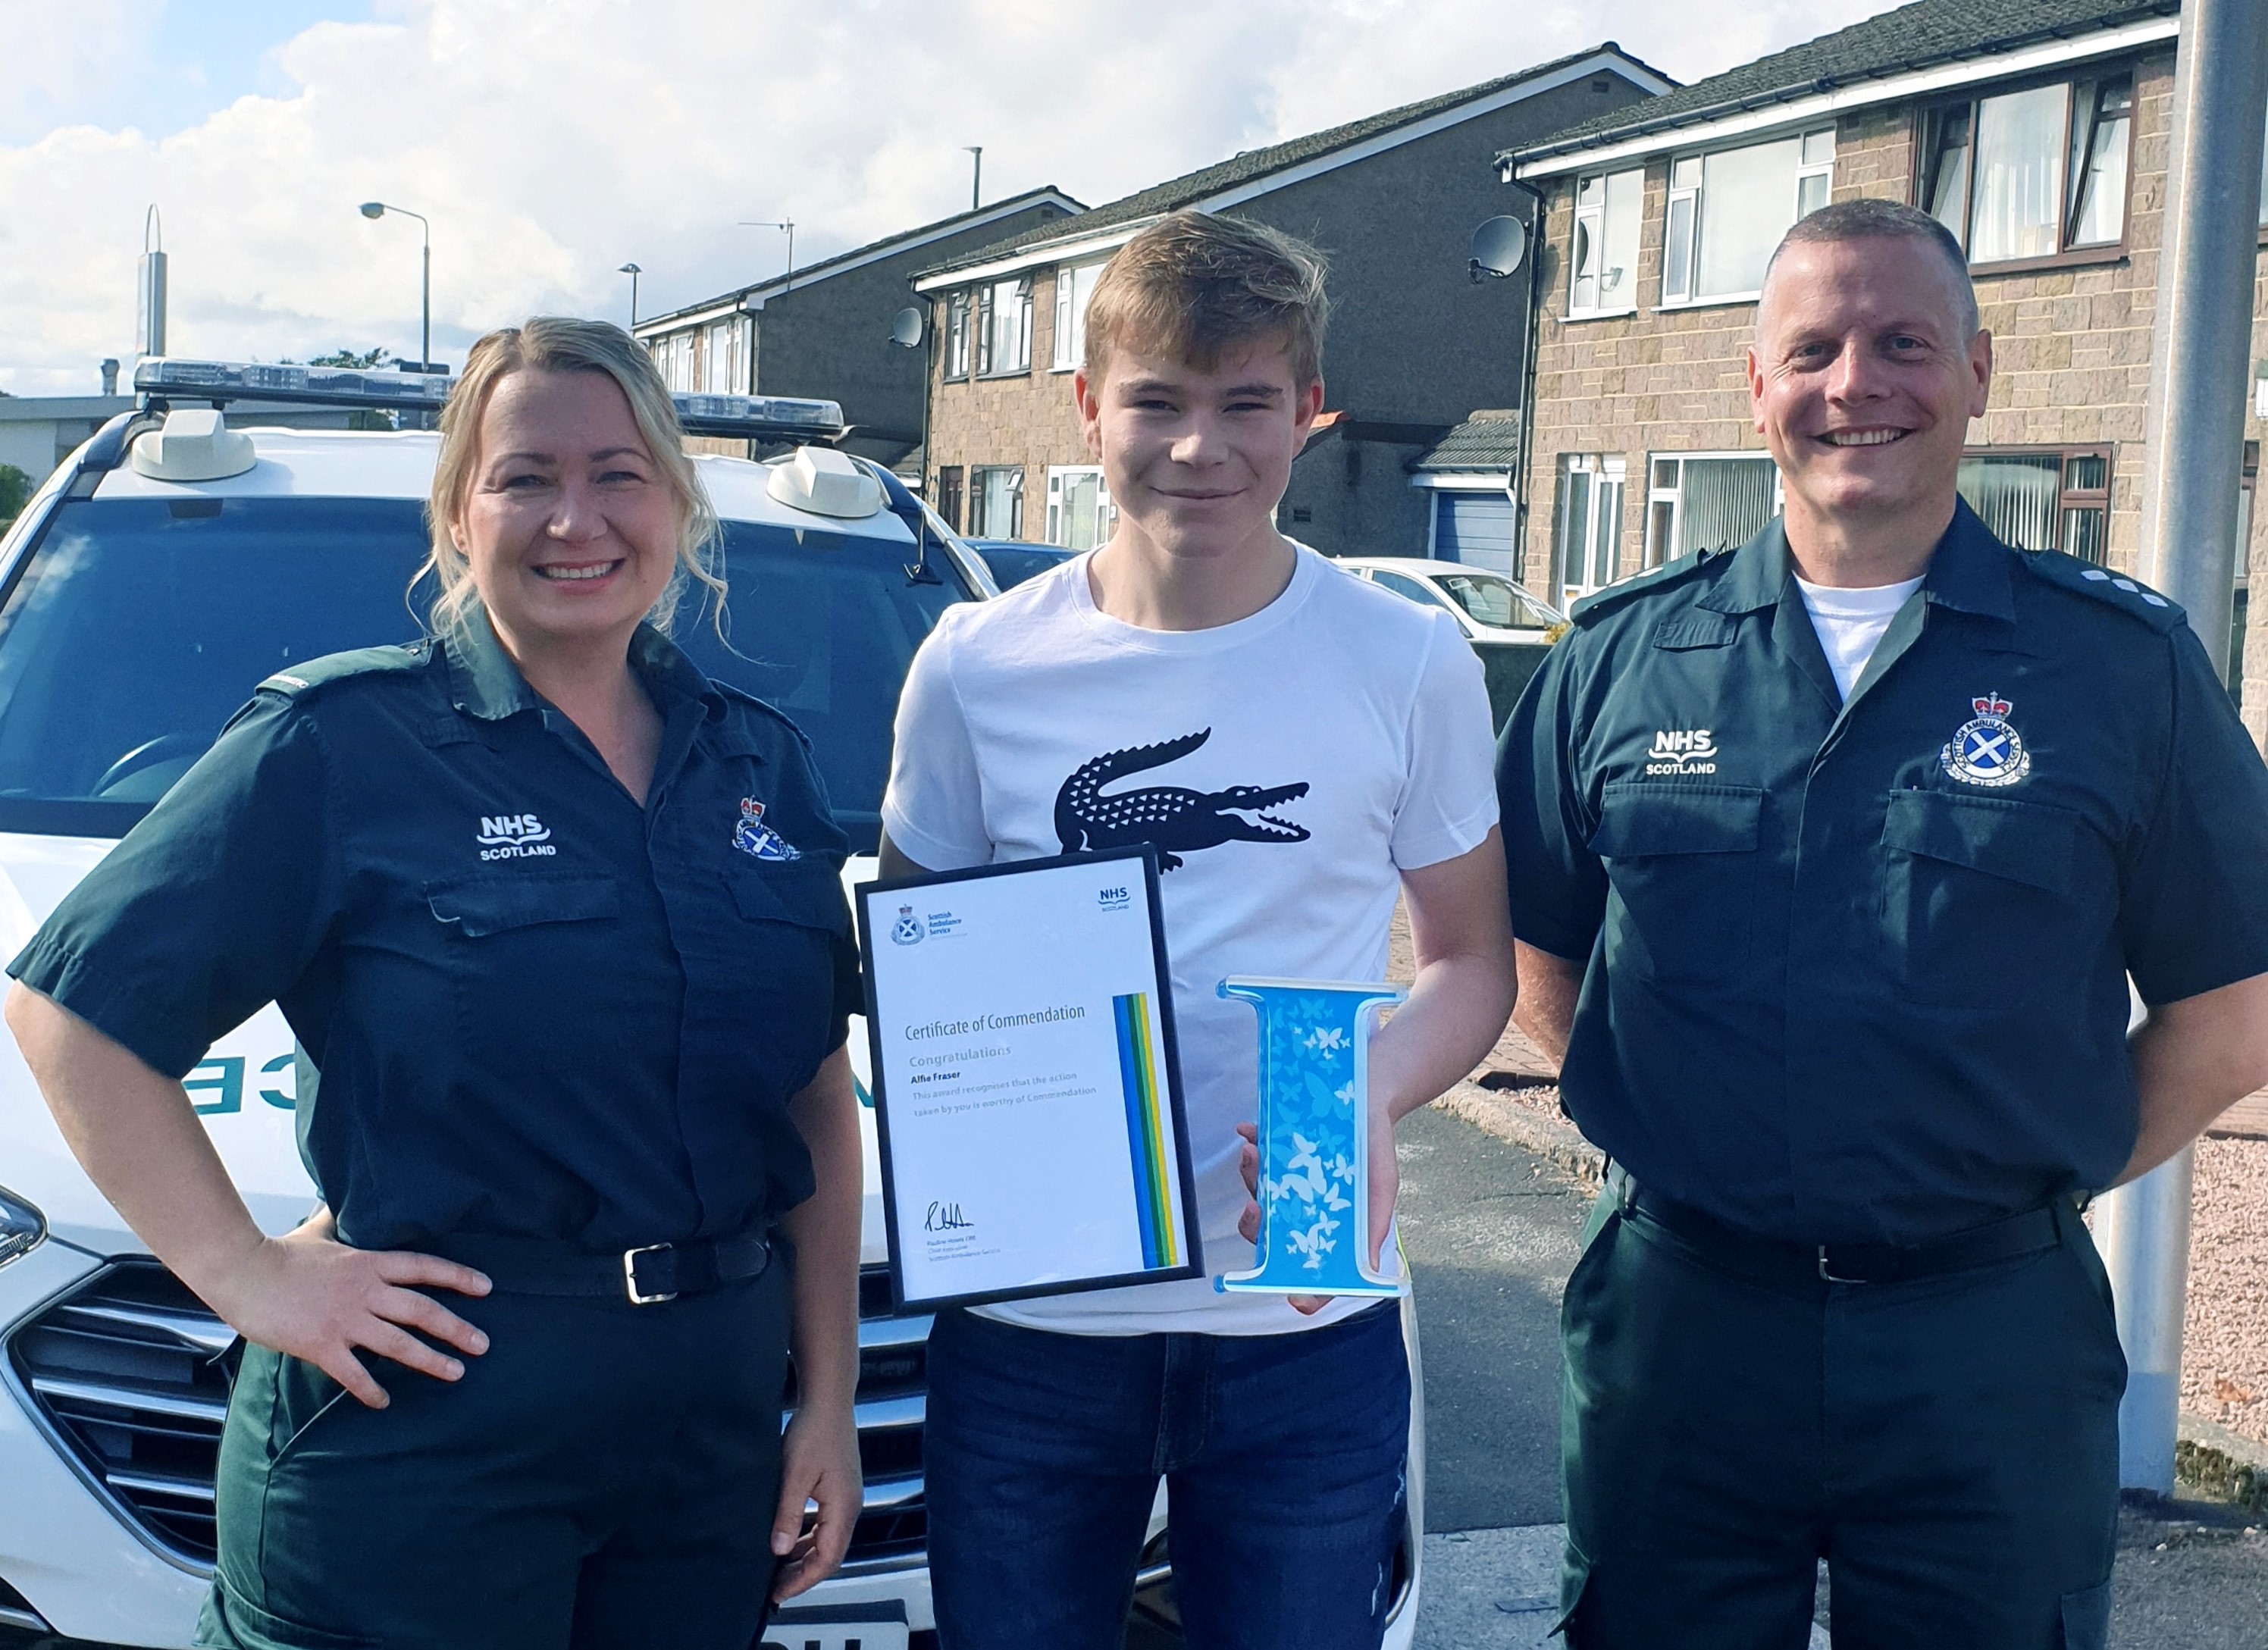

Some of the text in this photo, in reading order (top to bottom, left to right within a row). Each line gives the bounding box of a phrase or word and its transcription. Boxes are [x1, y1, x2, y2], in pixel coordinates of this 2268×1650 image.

[1654, 729, 1712, 751] NHS
[1646, 762, 1716, 775] SCOTLAND
[481, 813, 542, 838] NHS
[480, 844, 556, 861] SCOTLAND
[1100, 887, 1128, 900] NHS
[905, 1005, 1085, 1041] Certificate of Commendation
[909, 1046, 1011, 1067] Congratulations
[910, 1072, 960, 1085] Alfie Fraser
[932, 1087, 960, 1097] award
[962, 1081, 1009, 1092] recognises
[1012, 1078, 1030, 1087] that
[1032, 1076, 1046, 1085] the
[1049, 1073, 1077, 1082] action
[913, 1087, 1097, 1117] taken by you is worthy of Commendation
